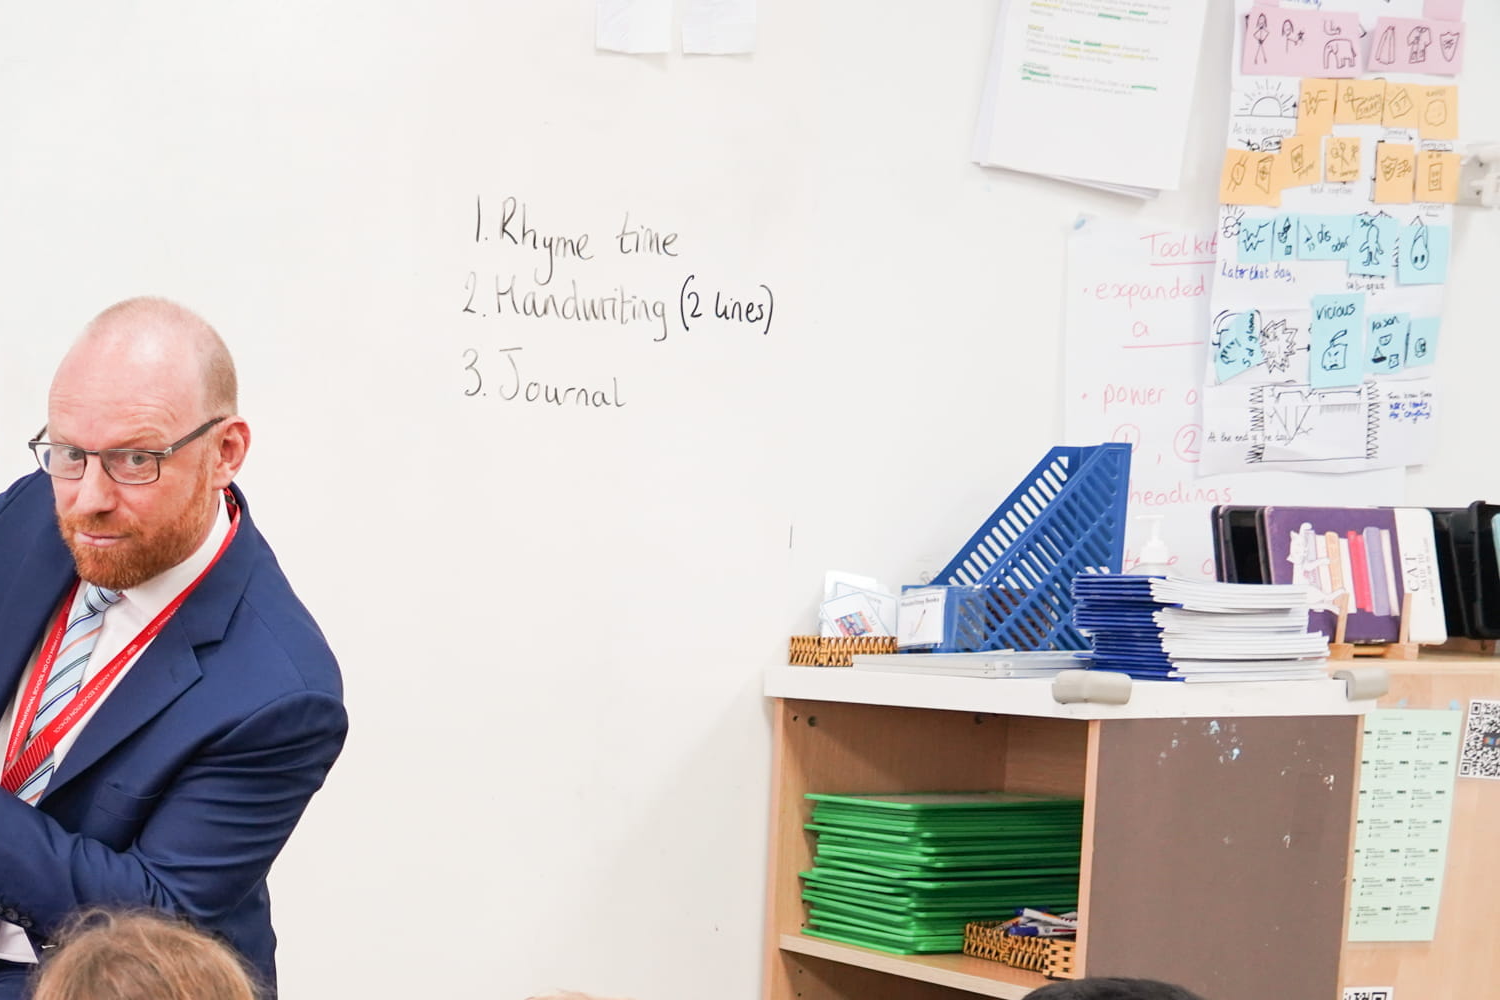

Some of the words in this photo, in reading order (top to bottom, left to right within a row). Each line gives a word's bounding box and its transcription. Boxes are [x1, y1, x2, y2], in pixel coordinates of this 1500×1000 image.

[499, 196, 594, 286] Rhyme
[616, 210, 679, 257] time
[495, 274, 668, 342] Handwriting
[1095, 274, 1206, 310] expanded
[498, 346, 627, 408] Journal
[1103, 383, 1165, 415] power
[1129, 480, 1234, 507] headings
